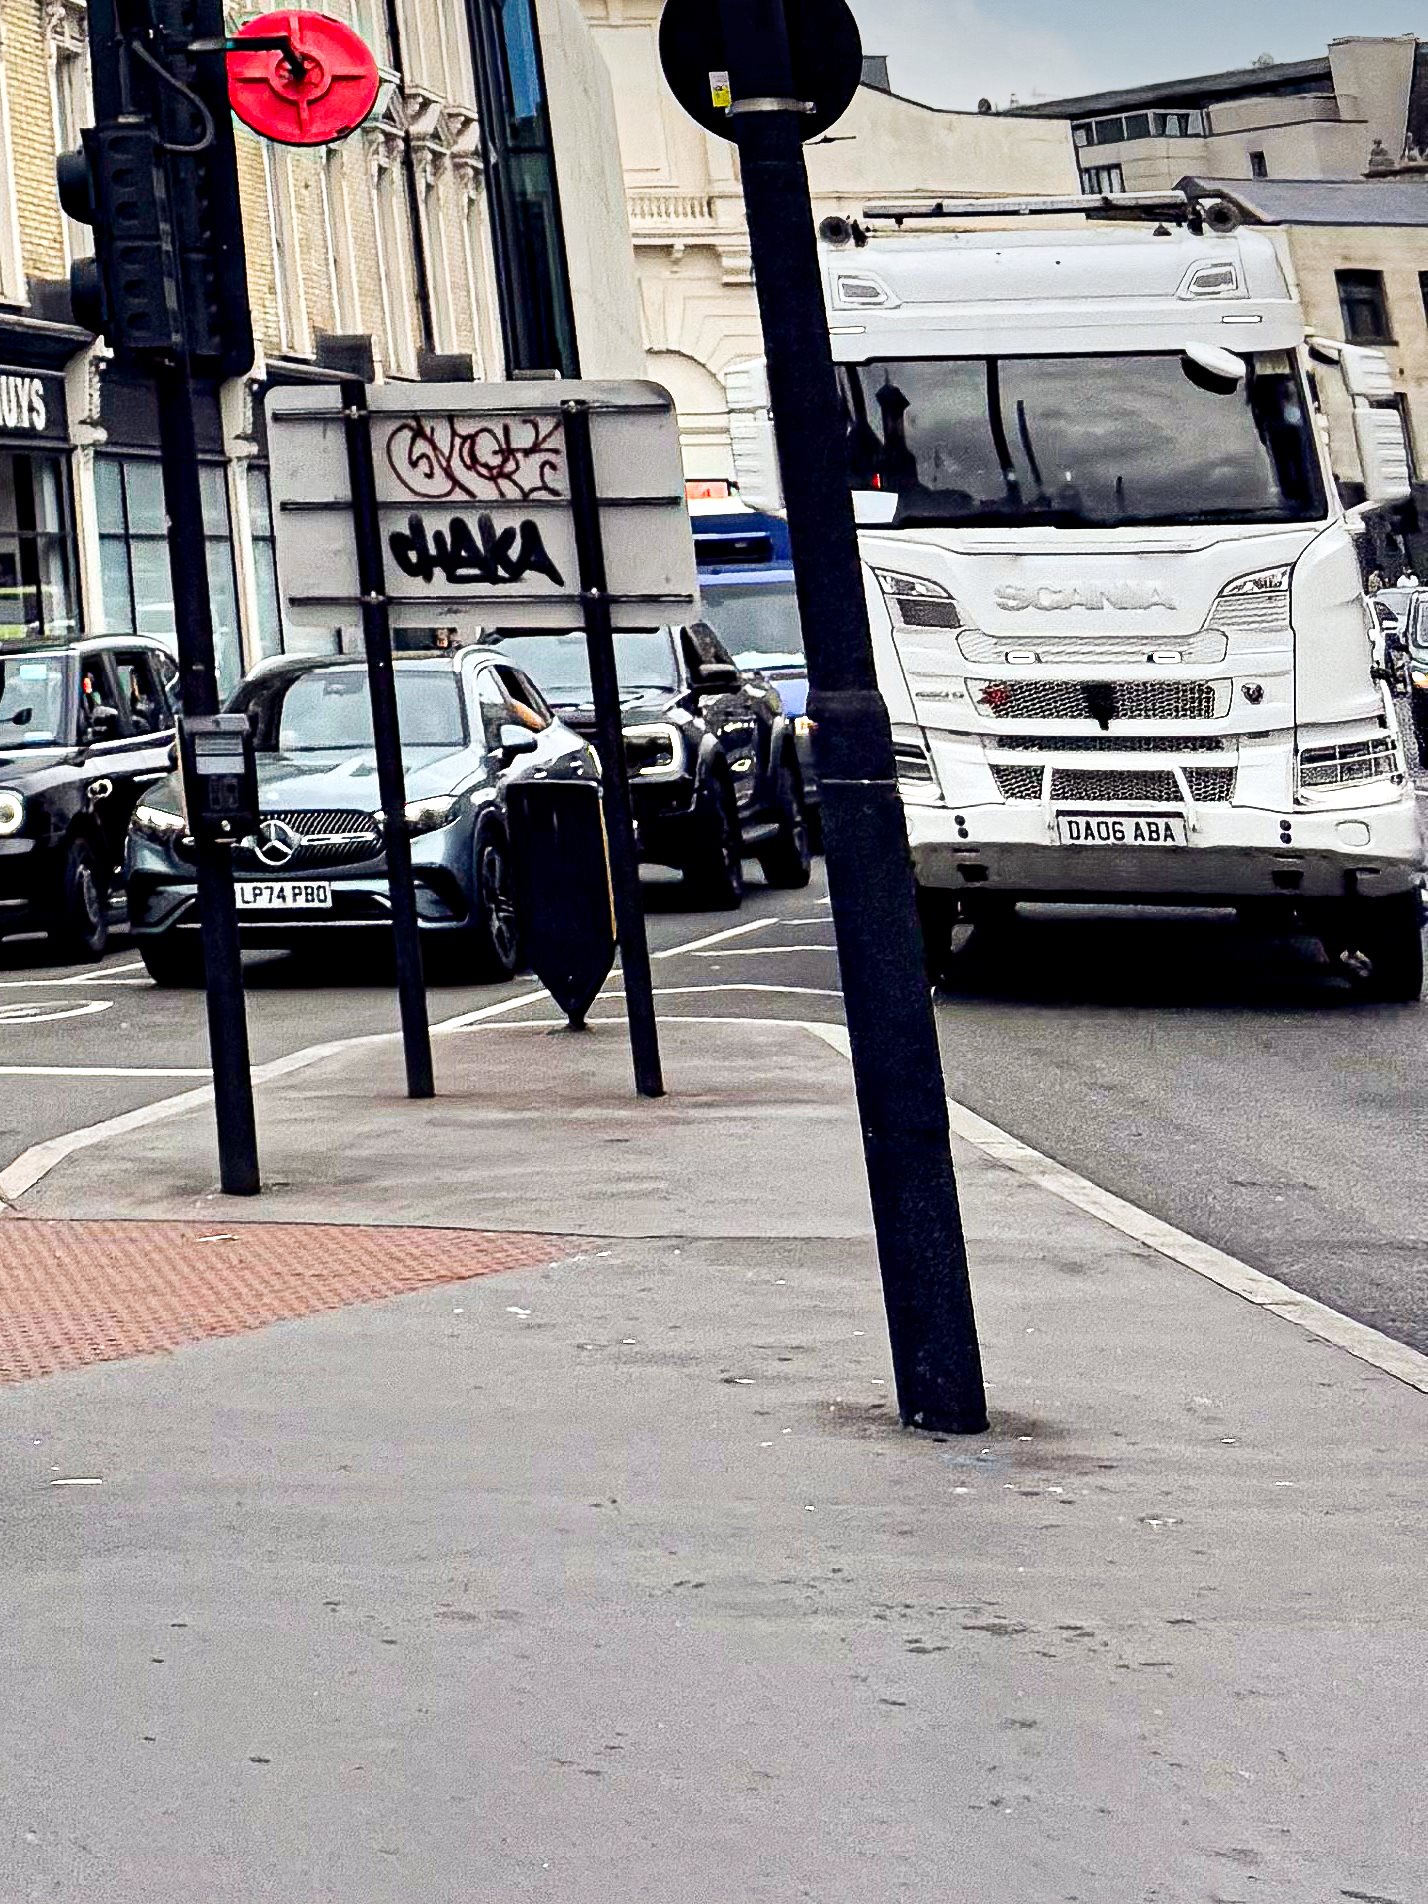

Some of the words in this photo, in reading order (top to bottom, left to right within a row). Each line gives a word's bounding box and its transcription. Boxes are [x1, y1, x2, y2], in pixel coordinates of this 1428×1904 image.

[993, 585, 1178, 613] SCANIA
[1066, 819, 1126, 842] DA06
[1133, 820, 1176, 843] ABA
[240, 885, 287, 905] LP74
